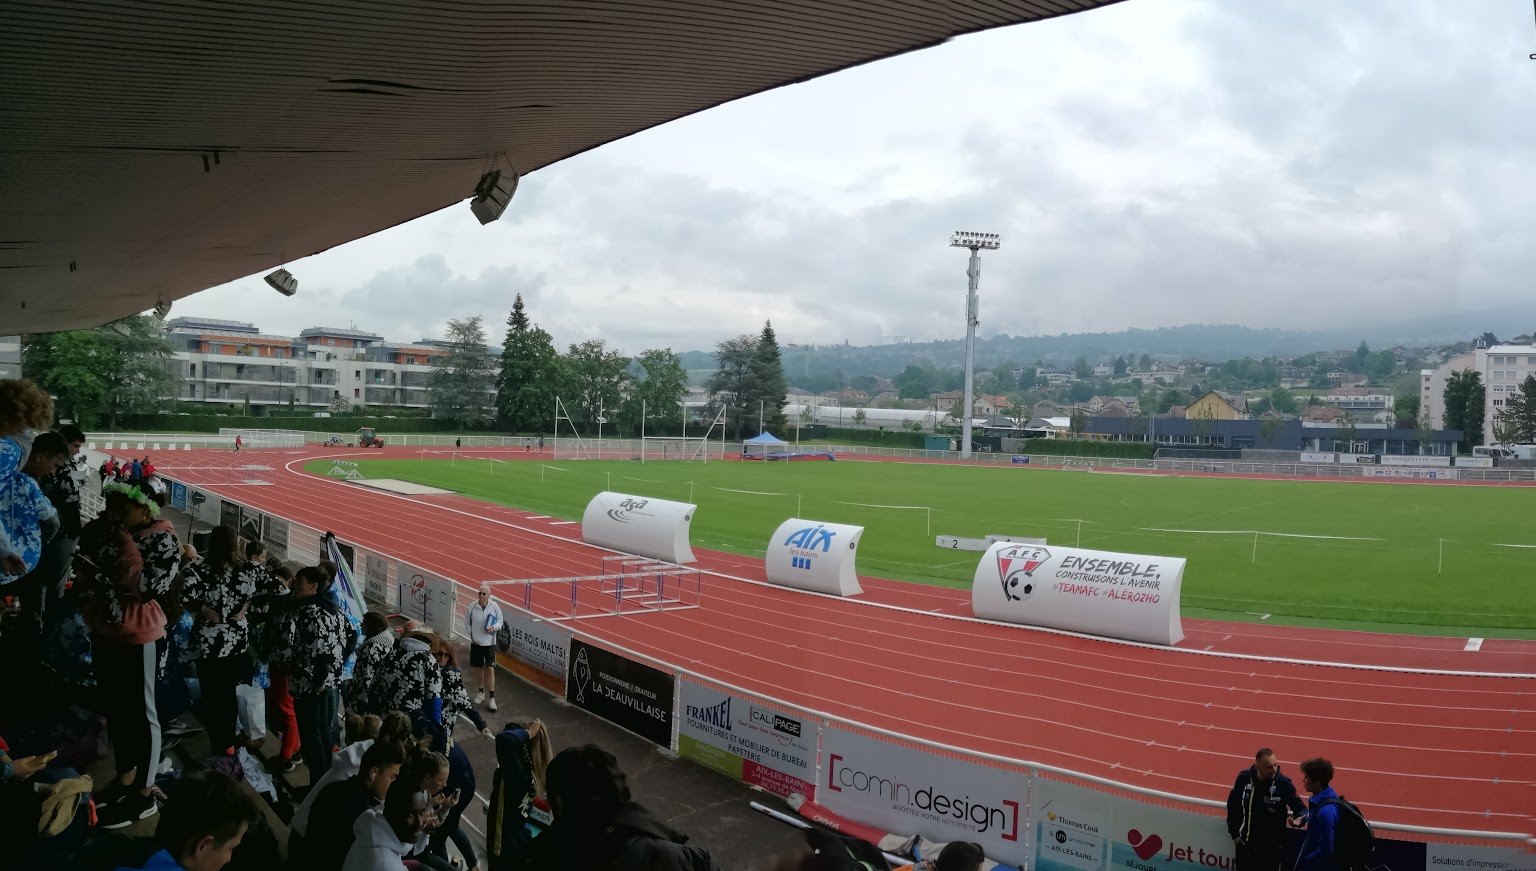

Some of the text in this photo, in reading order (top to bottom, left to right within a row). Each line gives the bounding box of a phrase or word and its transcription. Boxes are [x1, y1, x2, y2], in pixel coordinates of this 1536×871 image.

[952, 540, 958, 548] 2
[1060, 556, 1160, 580] ENSEMBLE,
[1056, 570, 1118, 586] CONSTRUISONS
[1052, 583, 1100, 597] #TEAMAFC
[512, 628, 566, 659] LES ROIS MALTS!
[592, 681, 667, 722] LA DEAUVILLAISE
[686, 696, 732, 731] FRANKEL
[687, 718, 729, 740] FOURNITURES
[730, 735, 738, 744] ET
[739, 738, 770, 756] MOBILIER
[771, 748, 781, 759] DE
[728, 744, 761, 763] PAPETERIE
[893, 804, 920, 817] BOOSTEZ
[922, 813, 941, 823] VOTRE
[1058, 815, 1100, 833] Thomas Cook
[1166, 843, 1194, 863] Jet
[1432, 856, 1465, 867] Solutions
